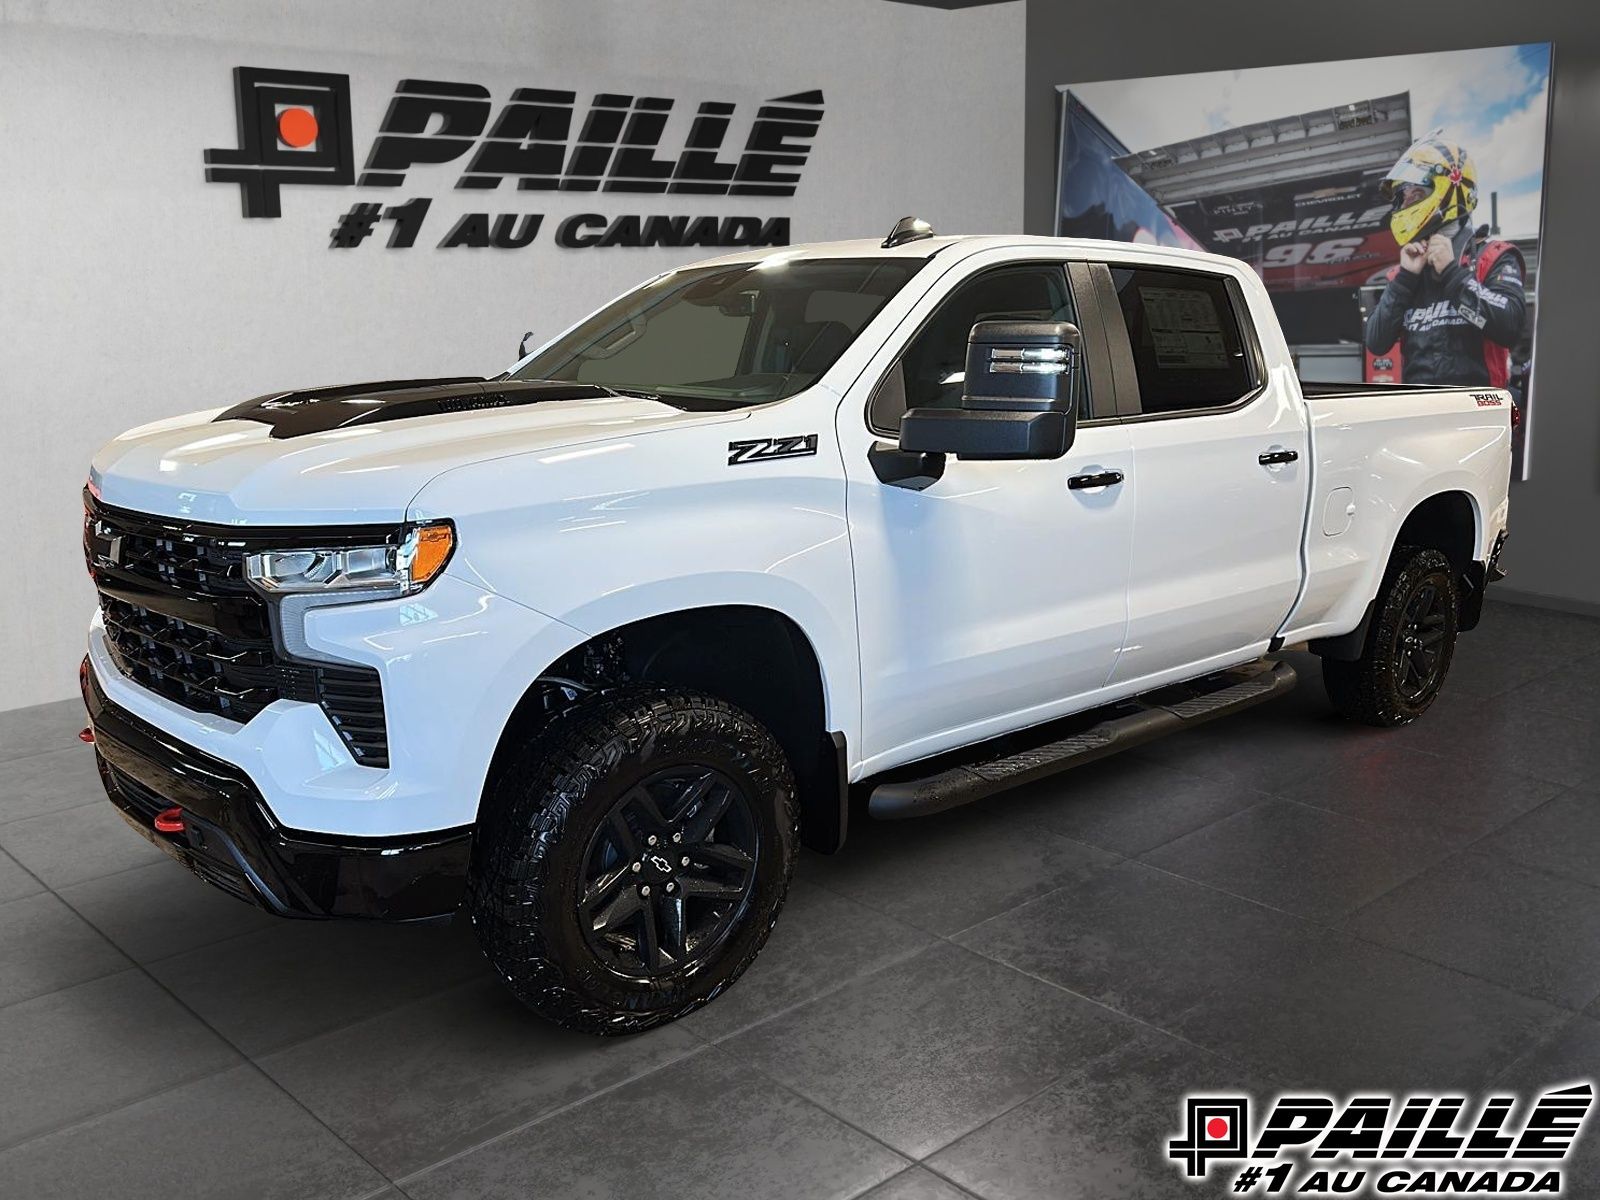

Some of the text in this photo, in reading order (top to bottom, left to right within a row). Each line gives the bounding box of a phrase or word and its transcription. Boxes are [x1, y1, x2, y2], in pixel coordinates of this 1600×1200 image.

[356, 79, 824, 197] PAILLÉ
[328, 198, 791, 249] #1 AU CANADA
[1267, 231, 1292, 240] AU
[1298, 221, 1381, 236] CANADA
[1263, 237, 1366, 268] 96
[1469, 393, 1504, 401] TRAIL
